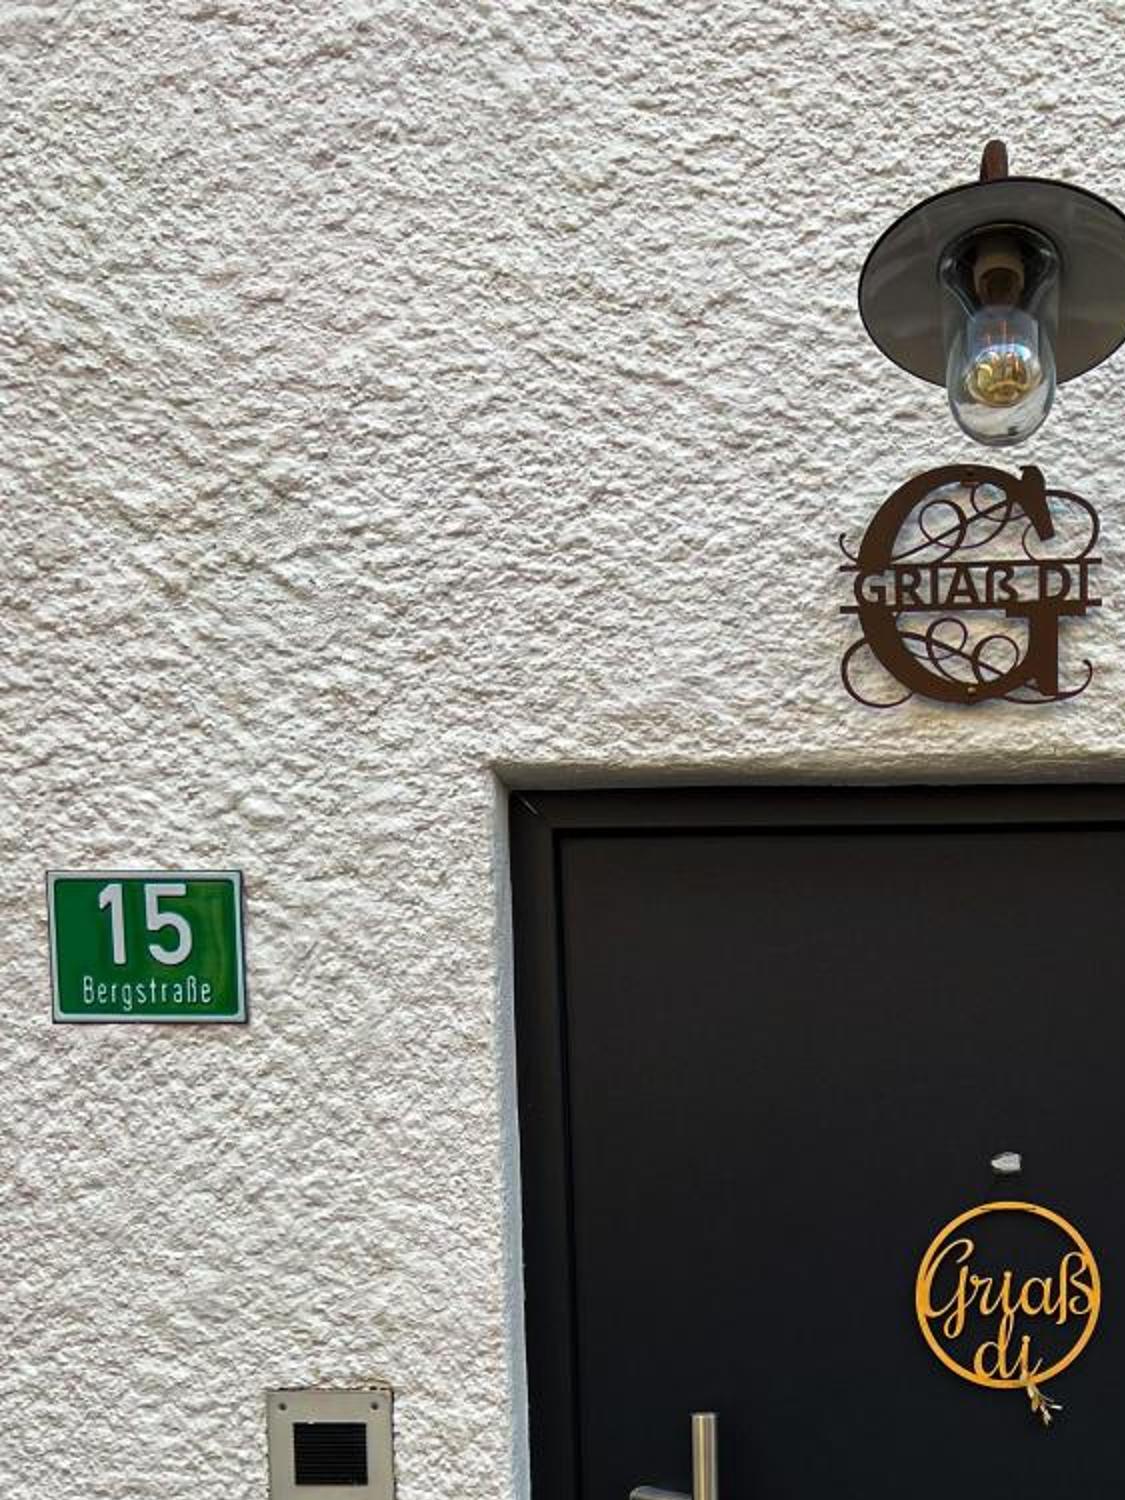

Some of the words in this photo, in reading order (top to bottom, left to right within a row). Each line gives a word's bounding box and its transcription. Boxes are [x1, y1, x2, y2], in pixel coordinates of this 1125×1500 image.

[1037, 562, 1089, 604] DI
[97, 883, 193, 965] 15
[82, 975, 212, 1012] Bergstraße
[923, 1238, 1093, 1340] Griaß
[973, 1312, 1044, 1380] di
